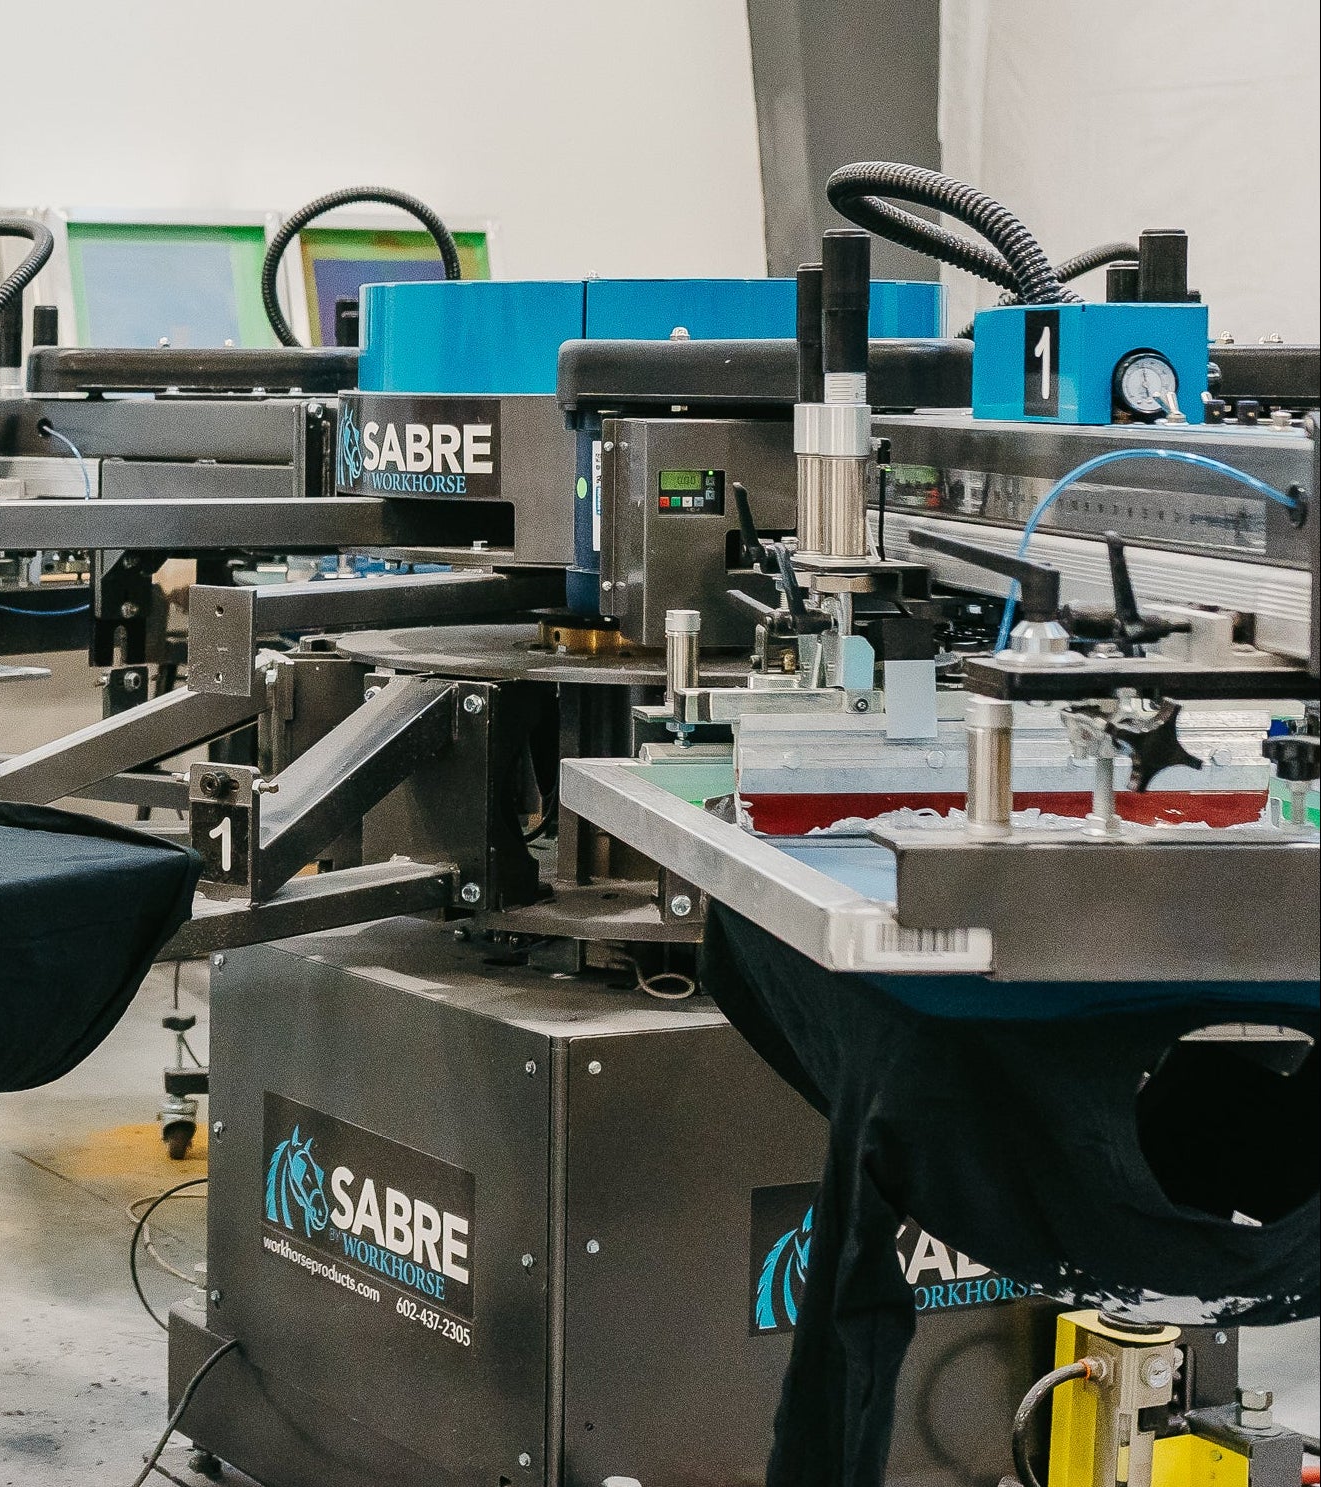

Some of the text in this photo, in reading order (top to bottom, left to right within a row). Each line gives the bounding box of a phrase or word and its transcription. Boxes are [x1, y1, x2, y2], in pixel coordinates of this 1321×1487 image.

[1034, 326, 1051, 400] 1
[363, 421, 493, 474] SABRE
[372, 472, 467, 494] WORKHORSE
[209, 816, 232, 872] 1
[330, 1166, 469, 1284] SABRE
[263, 1236, 471, 1347] workhorseproducts.com 602-437-2305
[341, 1232, 445, 1300] WORKHORSE
